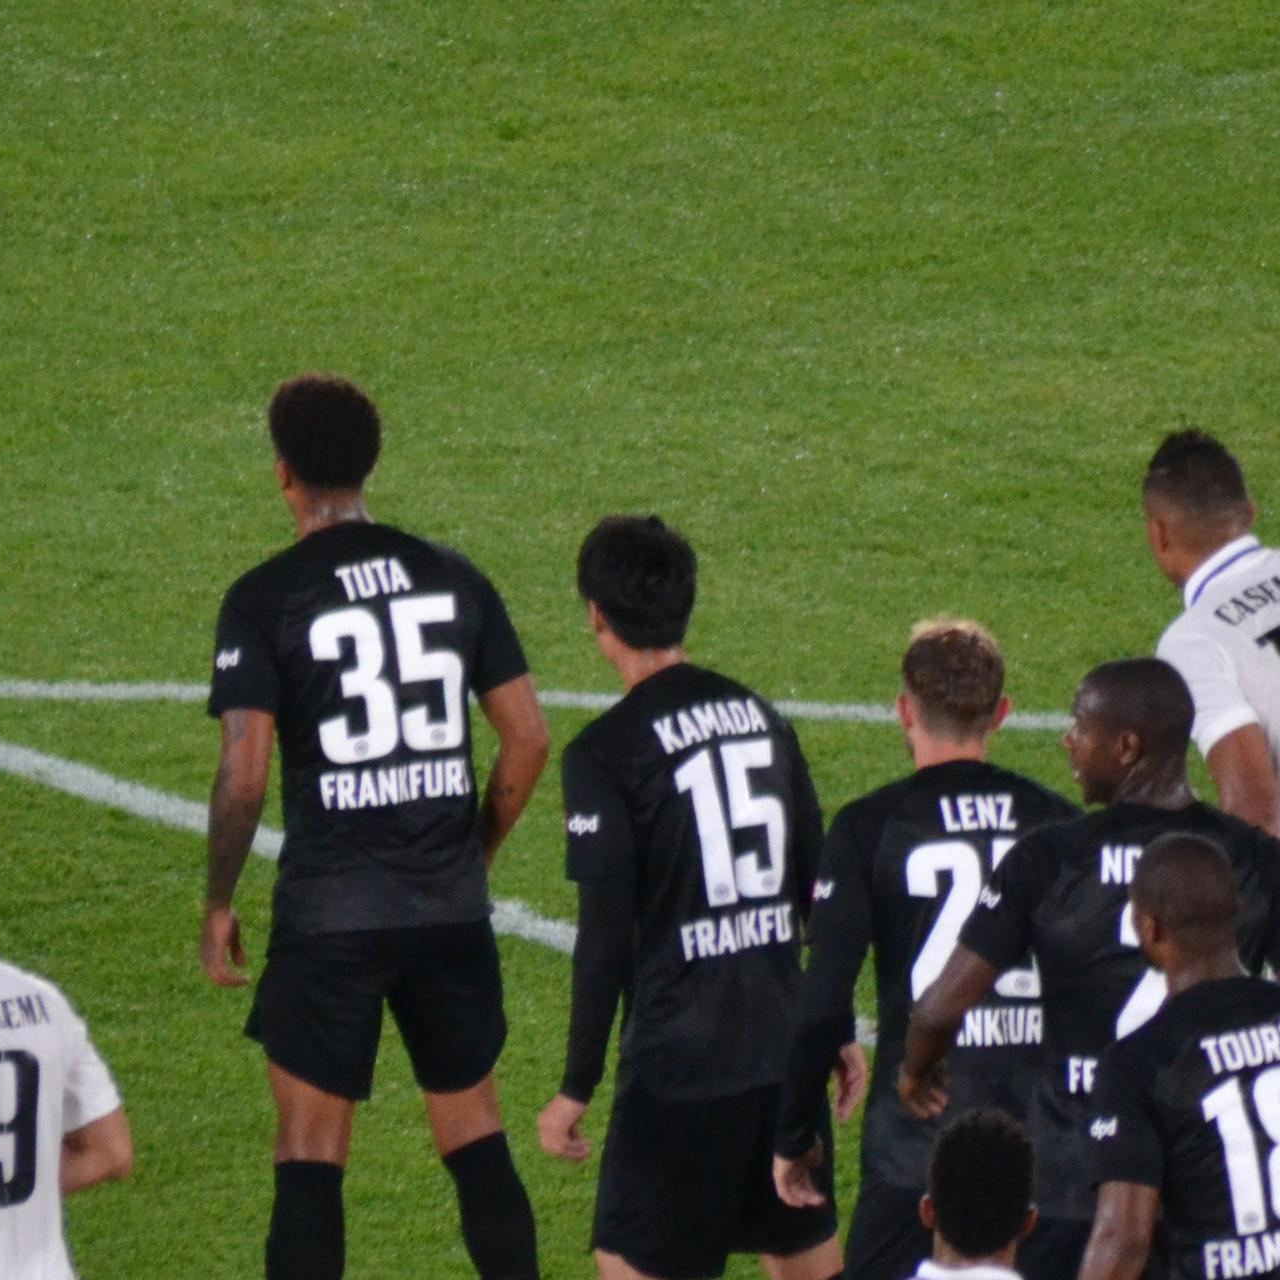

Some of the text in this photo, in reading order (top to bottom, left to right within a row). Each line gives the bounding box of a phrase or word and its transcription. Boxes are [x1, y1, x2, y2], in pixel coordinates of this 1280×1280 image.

[335, 557, 412, 601] TUTA
[309, 593, 464, 765] 35
[652, 698, 768, 755] KAMADA
[567, 814, 599, 836] dpd
[674, 738, 786, 908] 15
[939, 793, 1018, 833] LENZ
[1090, 1116, 1118, 1141] dpd
